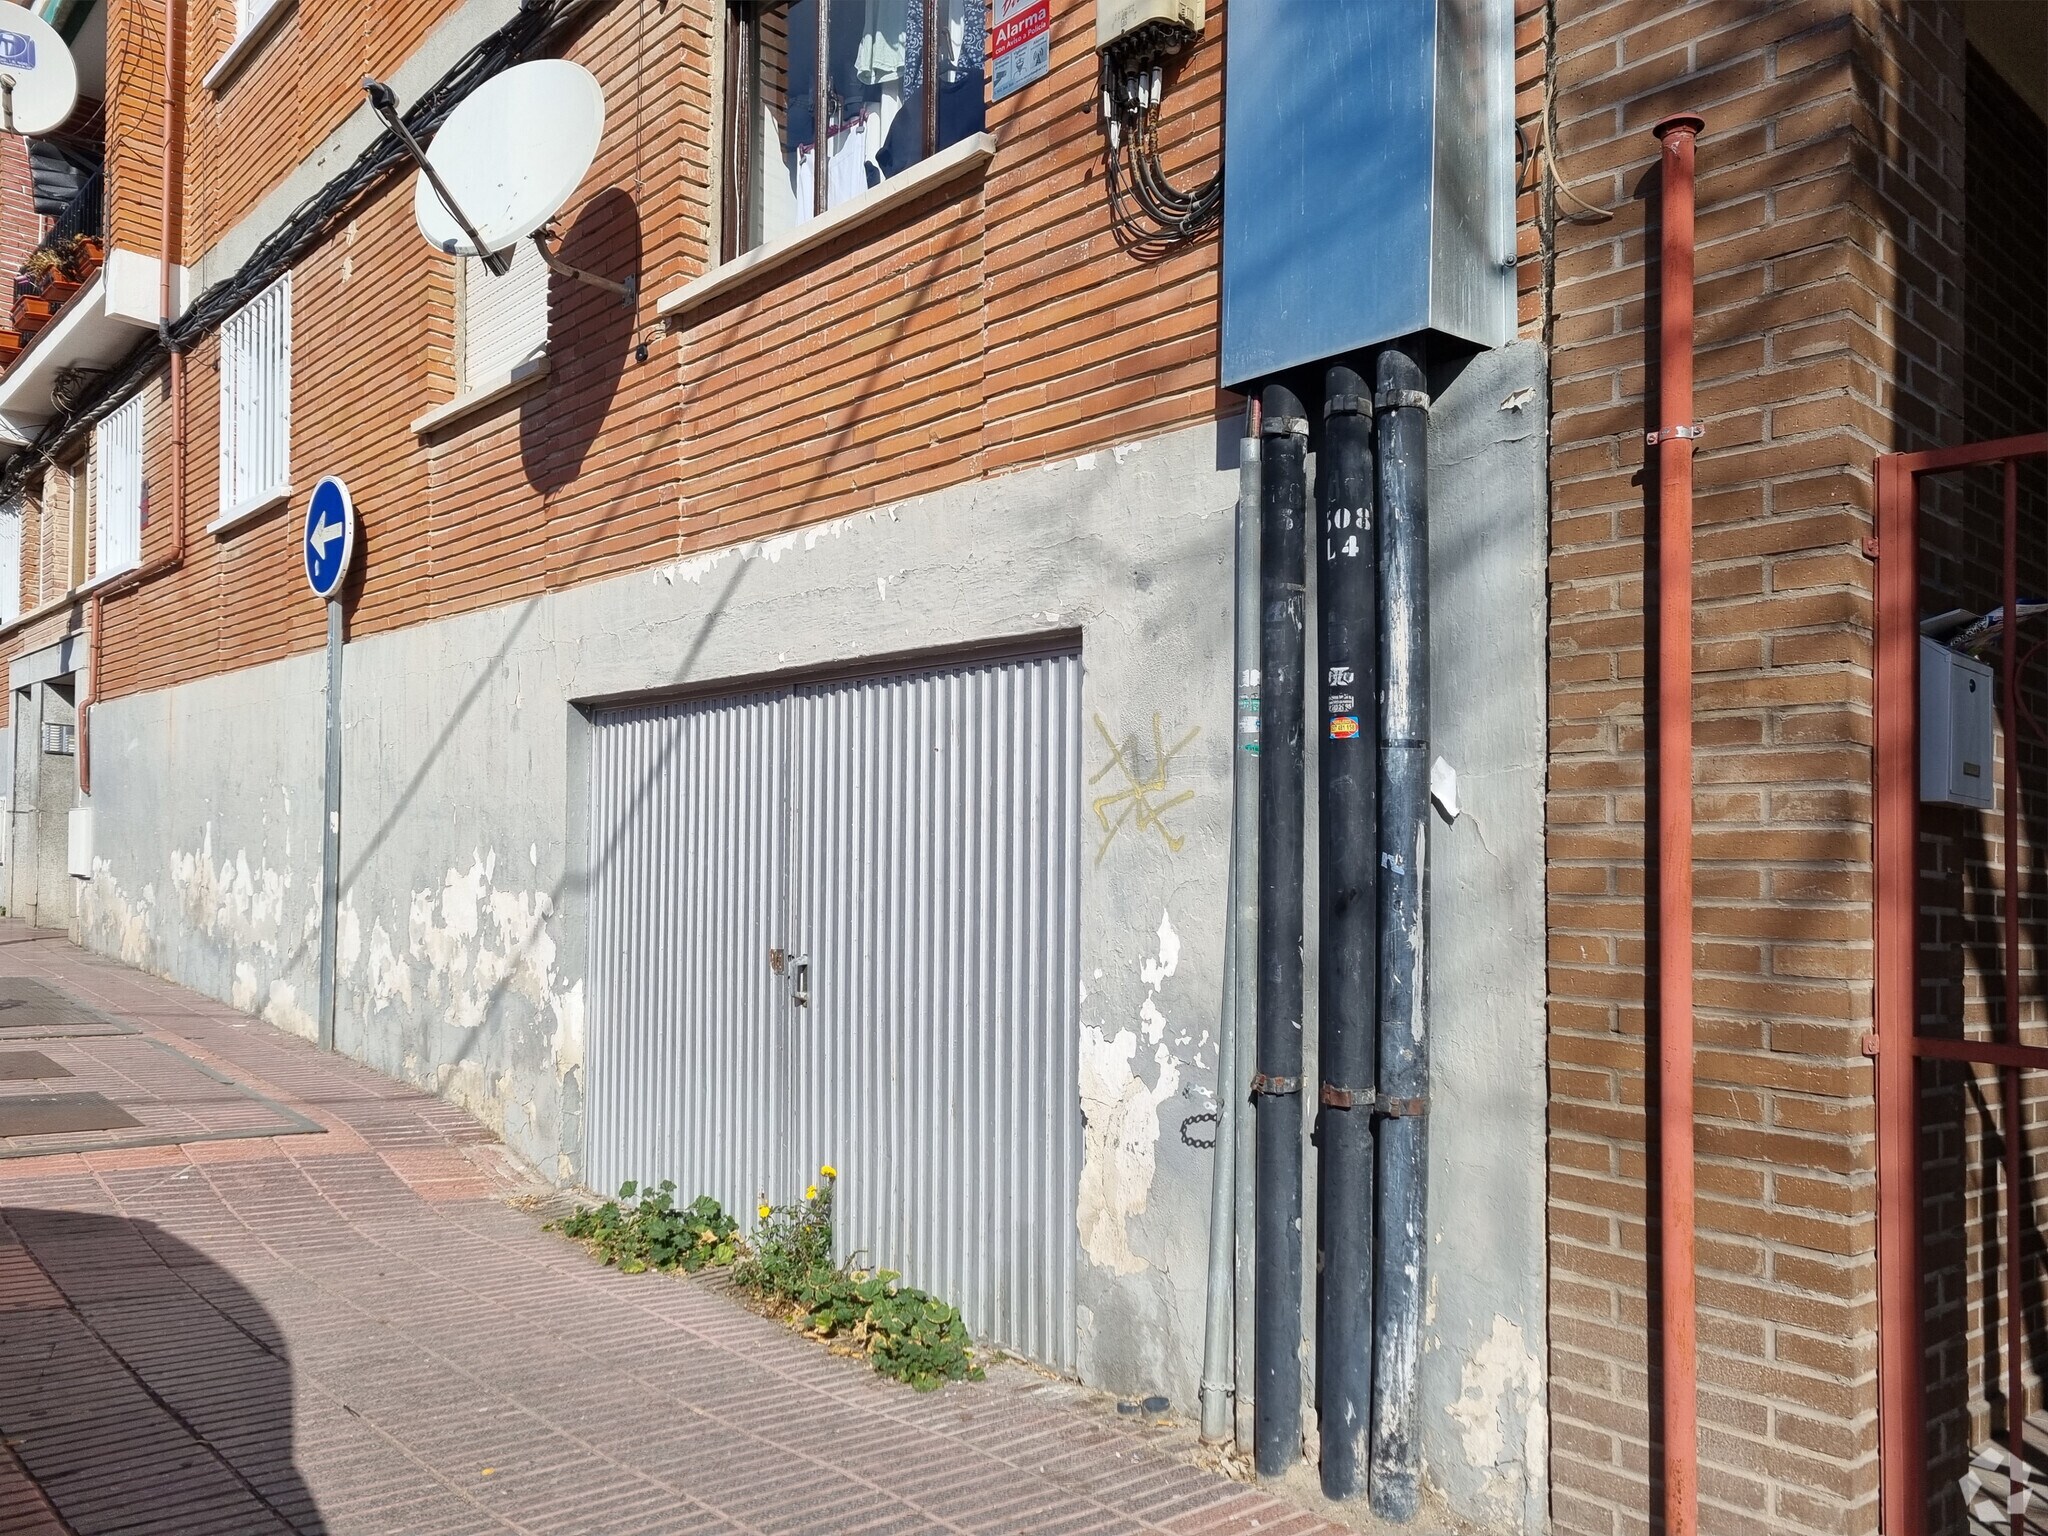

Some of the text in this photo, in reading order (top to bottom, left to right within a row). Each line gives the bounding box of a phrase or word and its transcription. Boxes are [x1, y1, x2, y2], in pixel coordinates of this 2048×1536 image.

[995, 8, 1046, 45] Alarma
[995, 46, 1006, 54] con
[1006, 36, 1022, 48] Aviso
